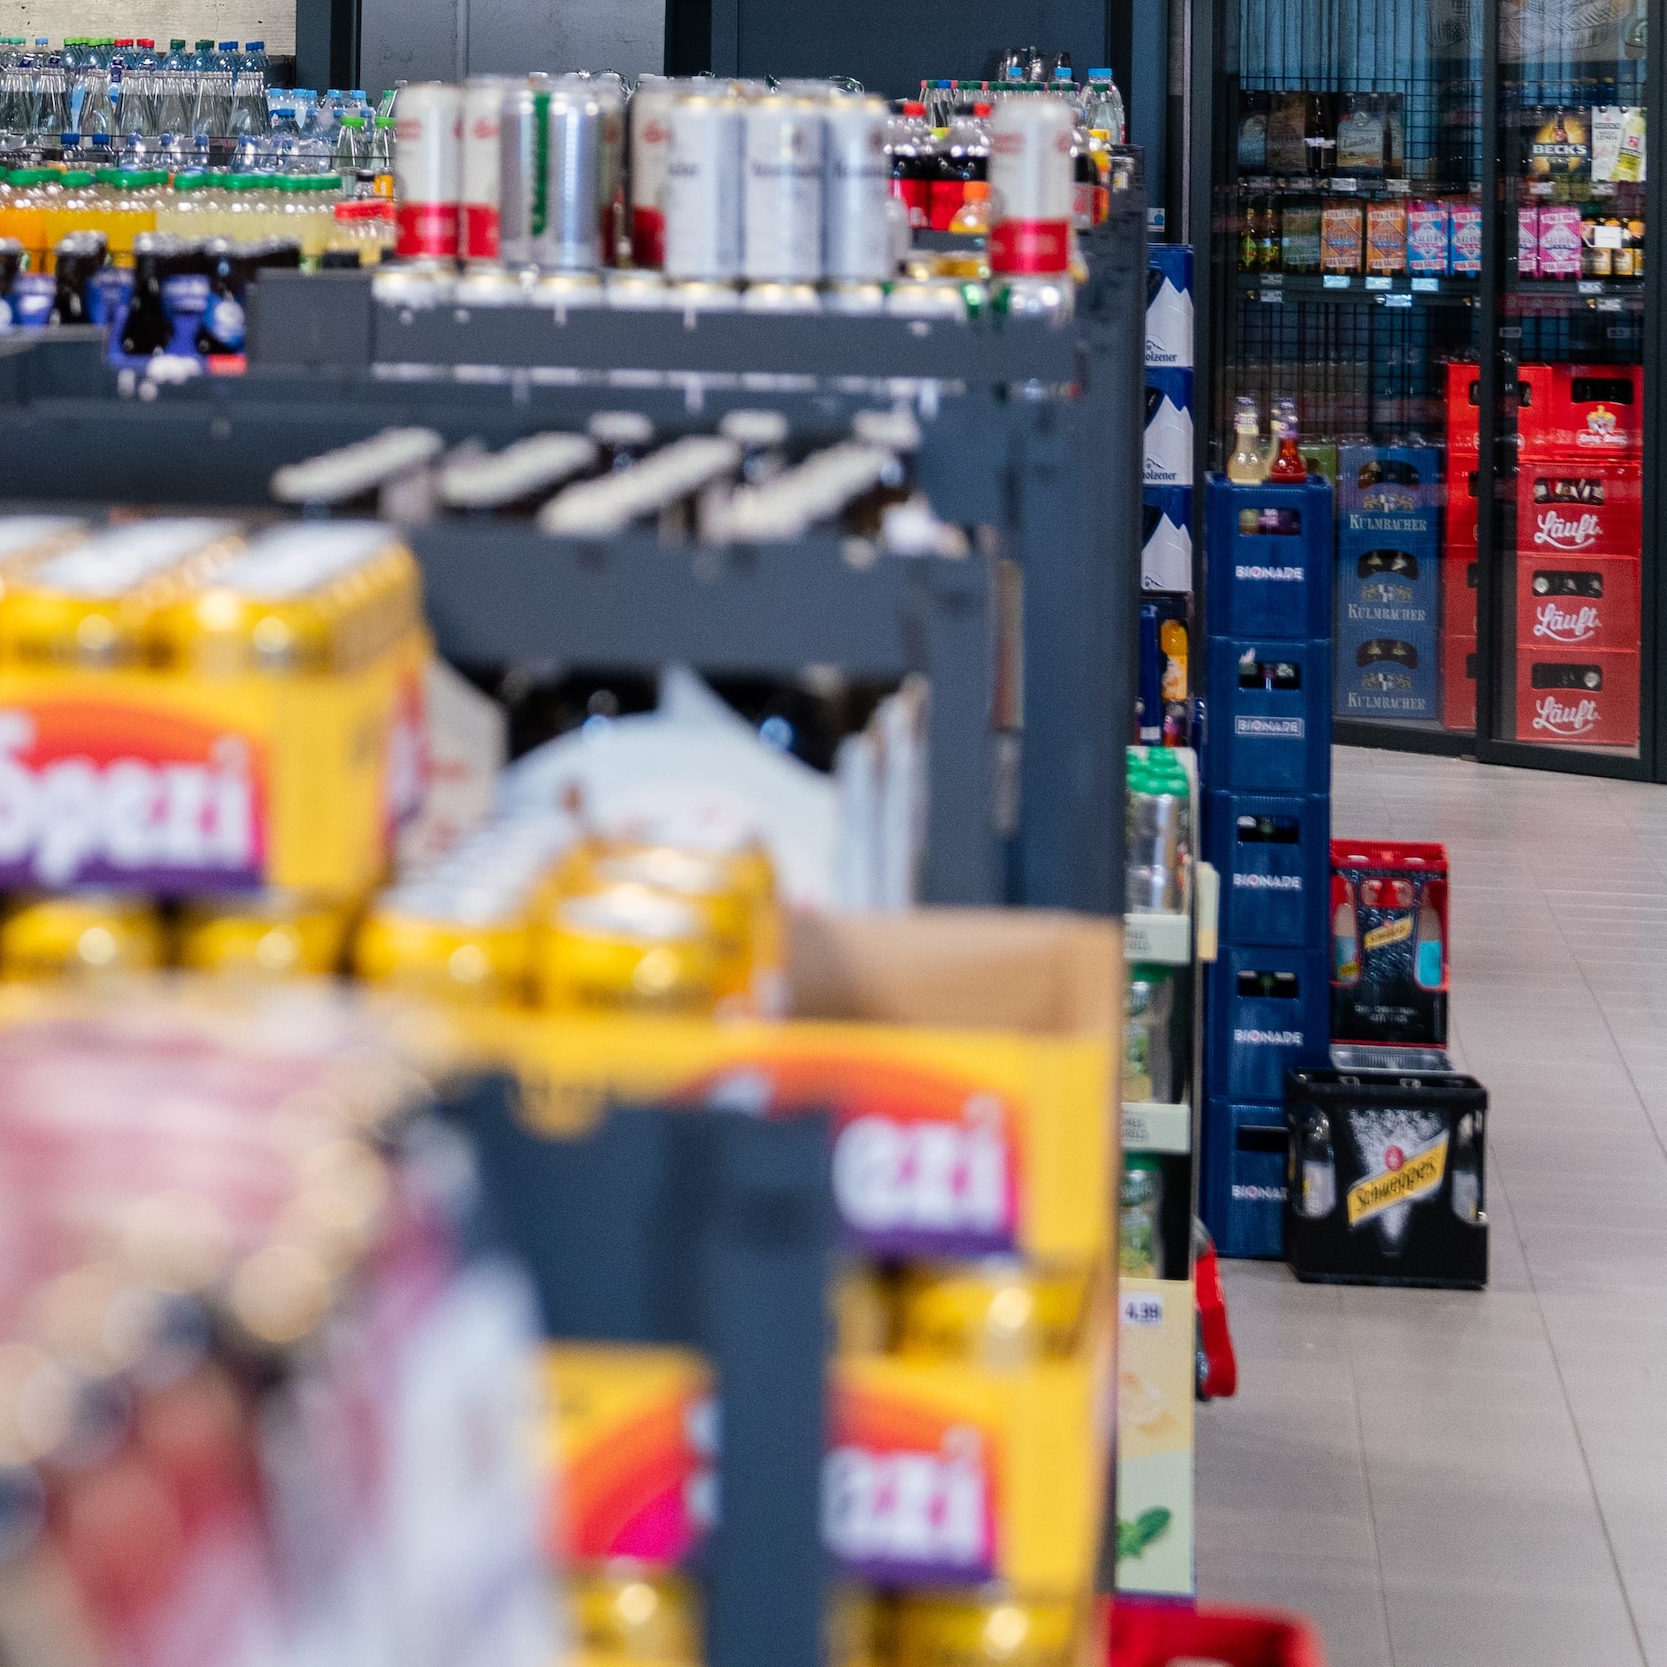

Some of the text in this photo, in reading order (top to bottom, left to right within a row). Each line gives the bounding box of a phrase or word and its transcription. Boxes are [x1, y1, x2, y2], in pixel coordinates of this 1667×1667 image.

[1145, 352, 1178, 363] olzener
[1349, 513, 1427, 532] KULMBACHER
[1235, 565, 1305, 582] BIONADE
[1347, 603, 1426, 622] KULMBACHER
[1347, 692, 1426, 711] KULMBACHER
[1238, 719, 1301, 734] BIONADE
[1233, 873, 1303, 890] BIONADE
[1234, 1029, 1304, 1046] BIONADE
